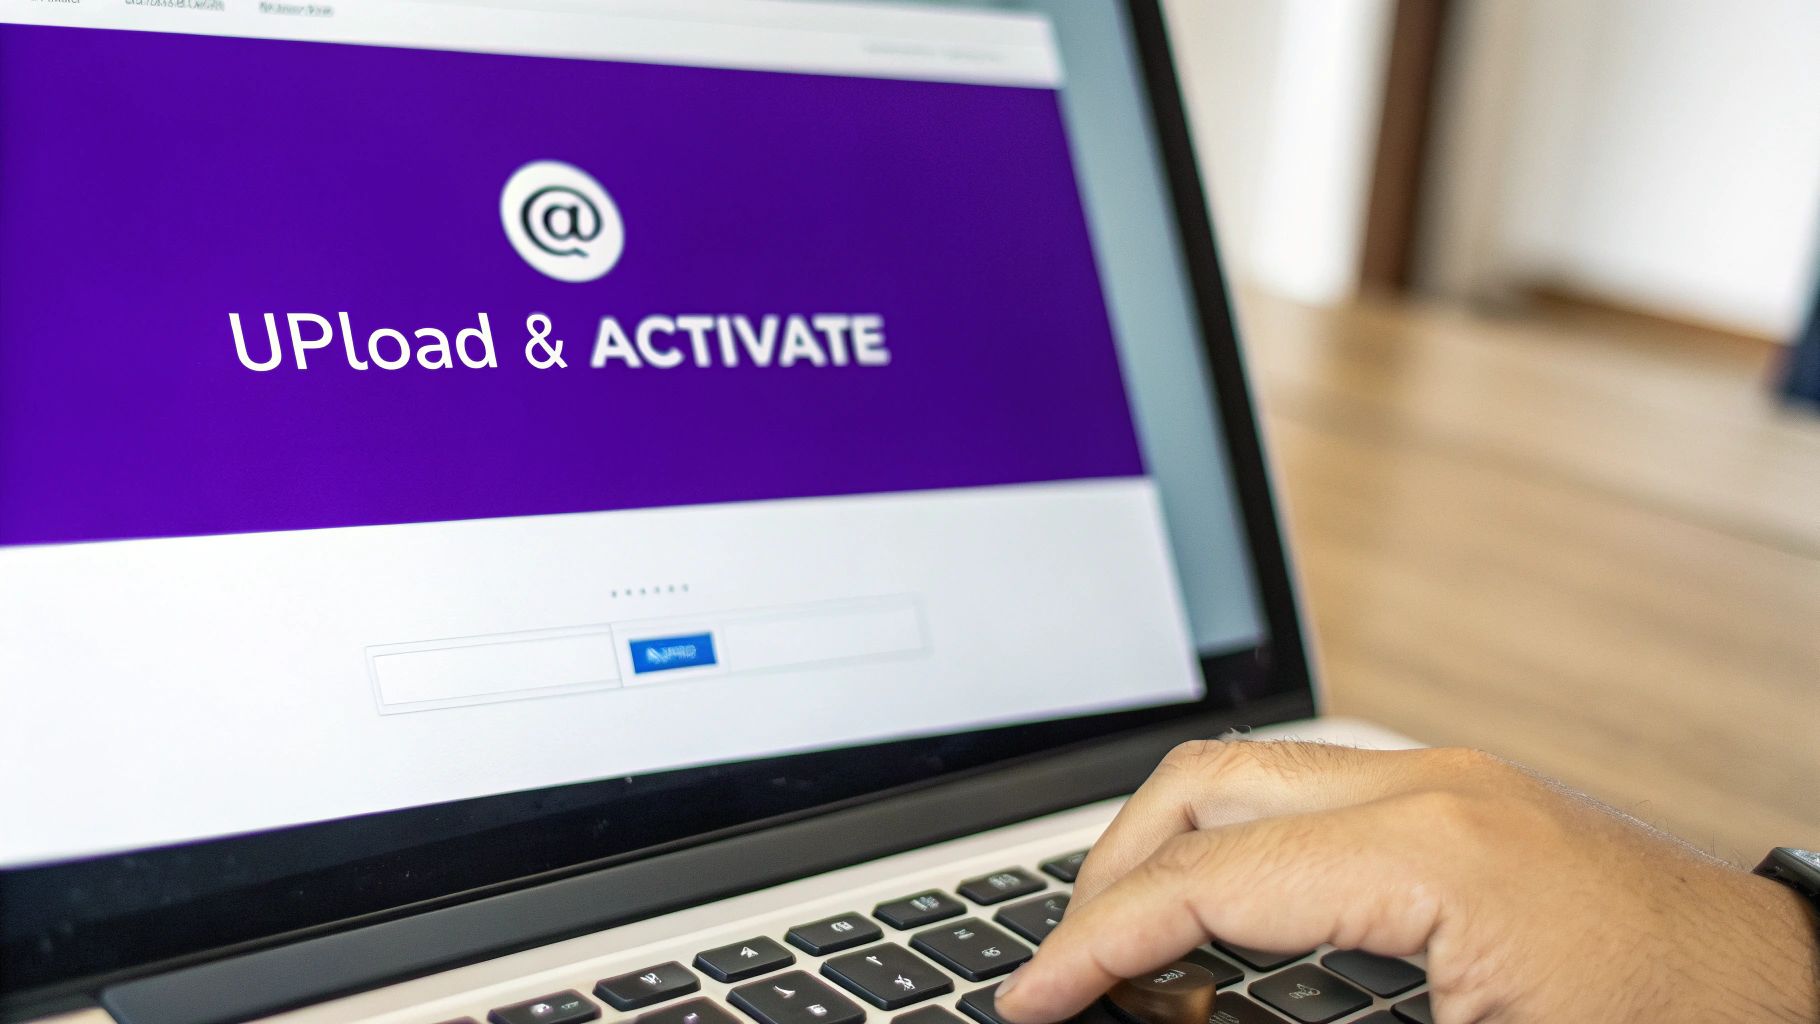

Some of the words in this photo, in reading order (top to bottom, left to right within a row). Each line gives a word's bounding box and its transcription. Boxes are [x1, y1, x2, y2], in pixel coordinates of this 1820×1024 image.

[520, 186, 602, 257] @
[228, 311, 498, 372] UPload
[524, 313, 568, 370] &
[590, 313, 890, 369] ACTIVATE
